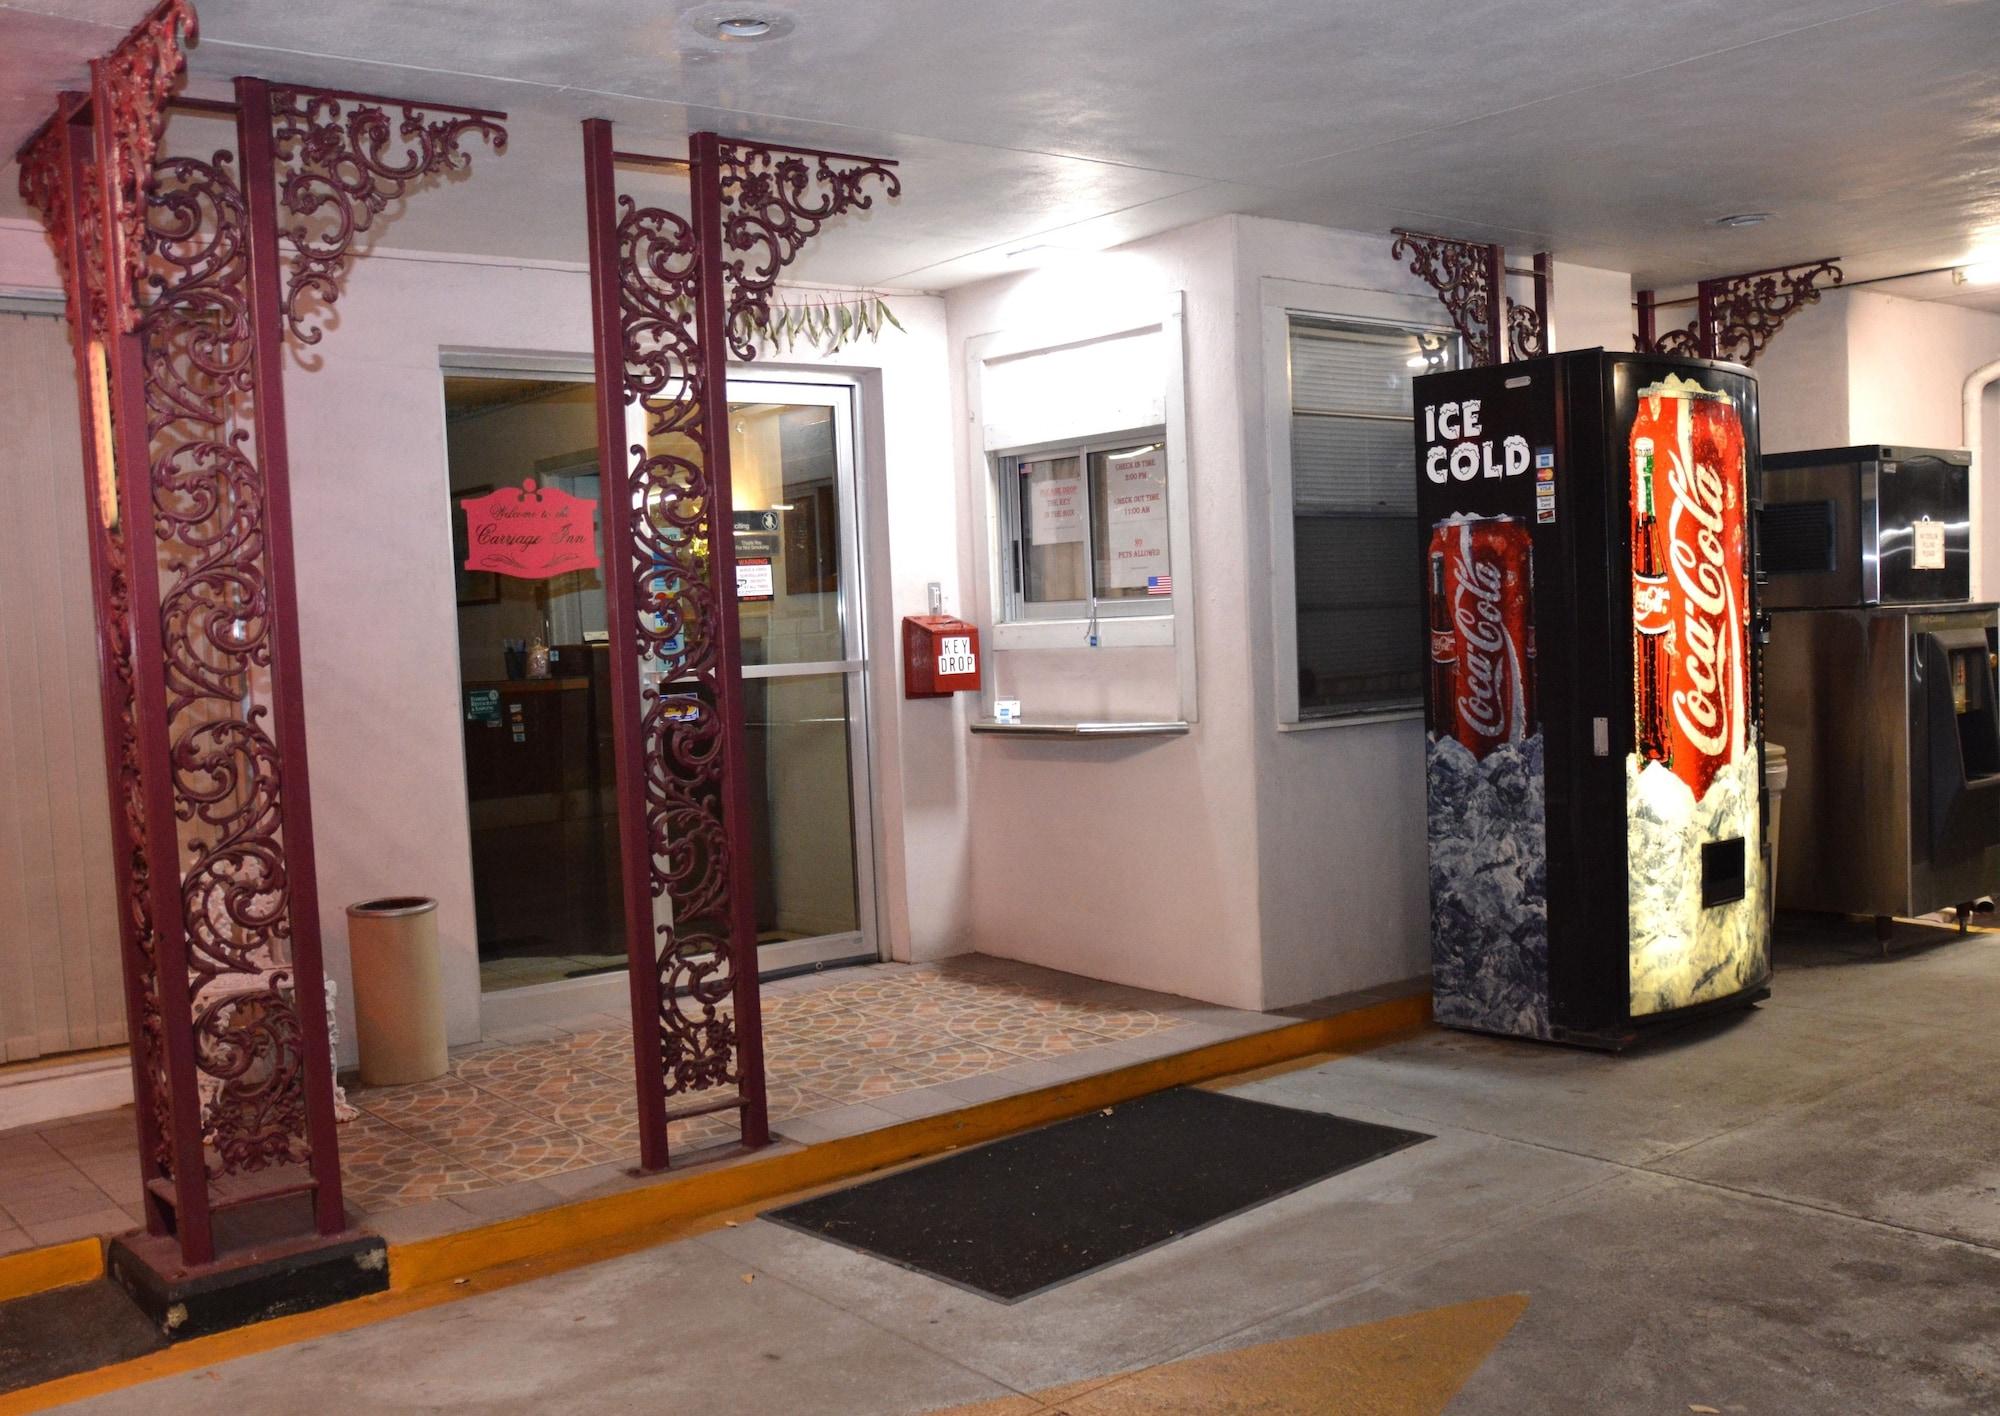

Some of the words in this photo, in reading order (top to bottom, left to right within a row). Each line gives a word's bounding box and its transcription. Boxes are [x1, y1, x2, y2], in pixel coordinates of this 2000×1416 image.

[1425, 400, 1482, 442] ICE
[1426, 435, 1531, 485] COLD
[490, 504, 536, 520] Welcome
[555, 506, 569, 518] the
[476, 523, 542, 552] Carriage
[552, 523, 586, 545] Inn
[944, 639, 967, 654] KEY
[941, 656, 973, 672] DROP
